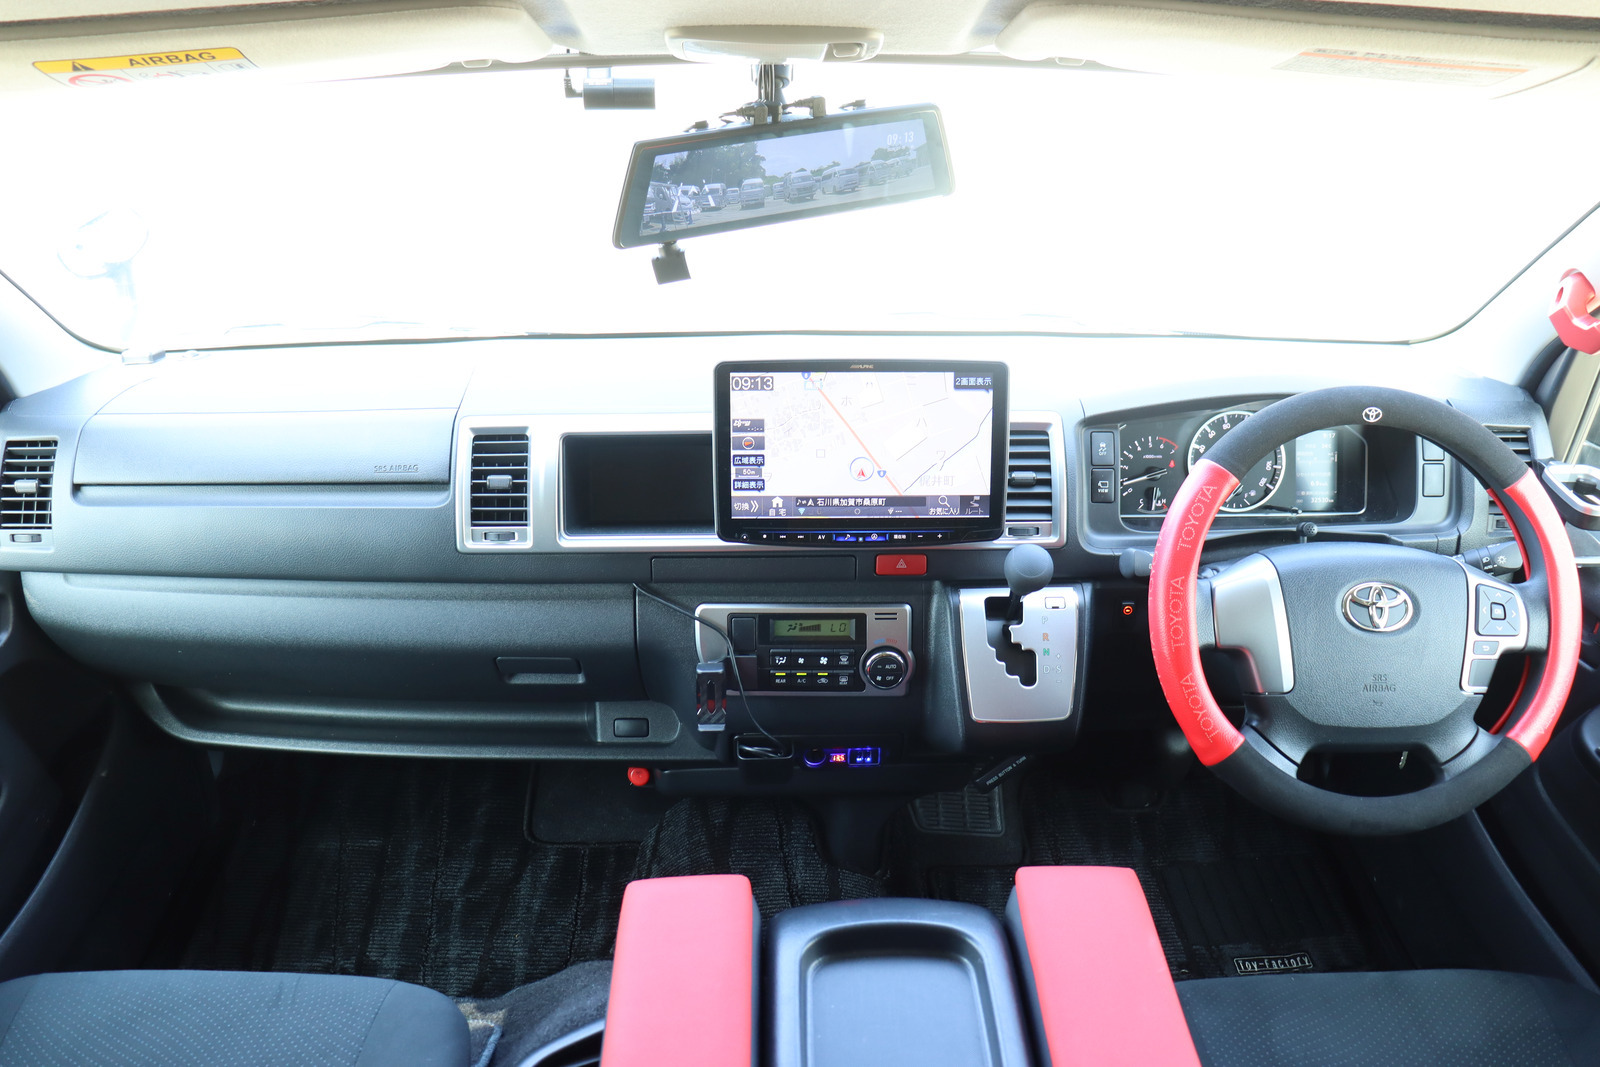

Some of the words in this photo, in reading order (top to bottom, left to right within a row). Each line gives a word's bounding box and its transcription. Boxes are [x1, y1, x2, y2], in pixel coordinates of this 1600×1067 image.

[128, 51, 217, 67] AIRBAG
[887, 131, 914, 146] 09:13
[732, 376, 773, 390] 09:13
[955, 377, 992, 386] 2画面表示
[389, 464, 419, 472] AIRBAG
[733, 502, 750, 511] 切換
[928, 507, 960, 516] お気に入り
[1177, 485, 1217, 551] TOYOTA
[1169, 576, 1185, 652] TOYOTA
[1042, 616, 1049, 624] P
[1042, 632, 1050, 641] R
[1043, 648, 1050, 656] N
[1043, 665, 1050, 674] D
[1056, 665, 1062, 674] S
[1372, 673, 1388, 682] SRS
[1362, 683, 1397, 693] AIRBAG
[1180, 672, 1220, 743] TOYOTA
[1238, 956, 1309, 972] Toy-Factory
